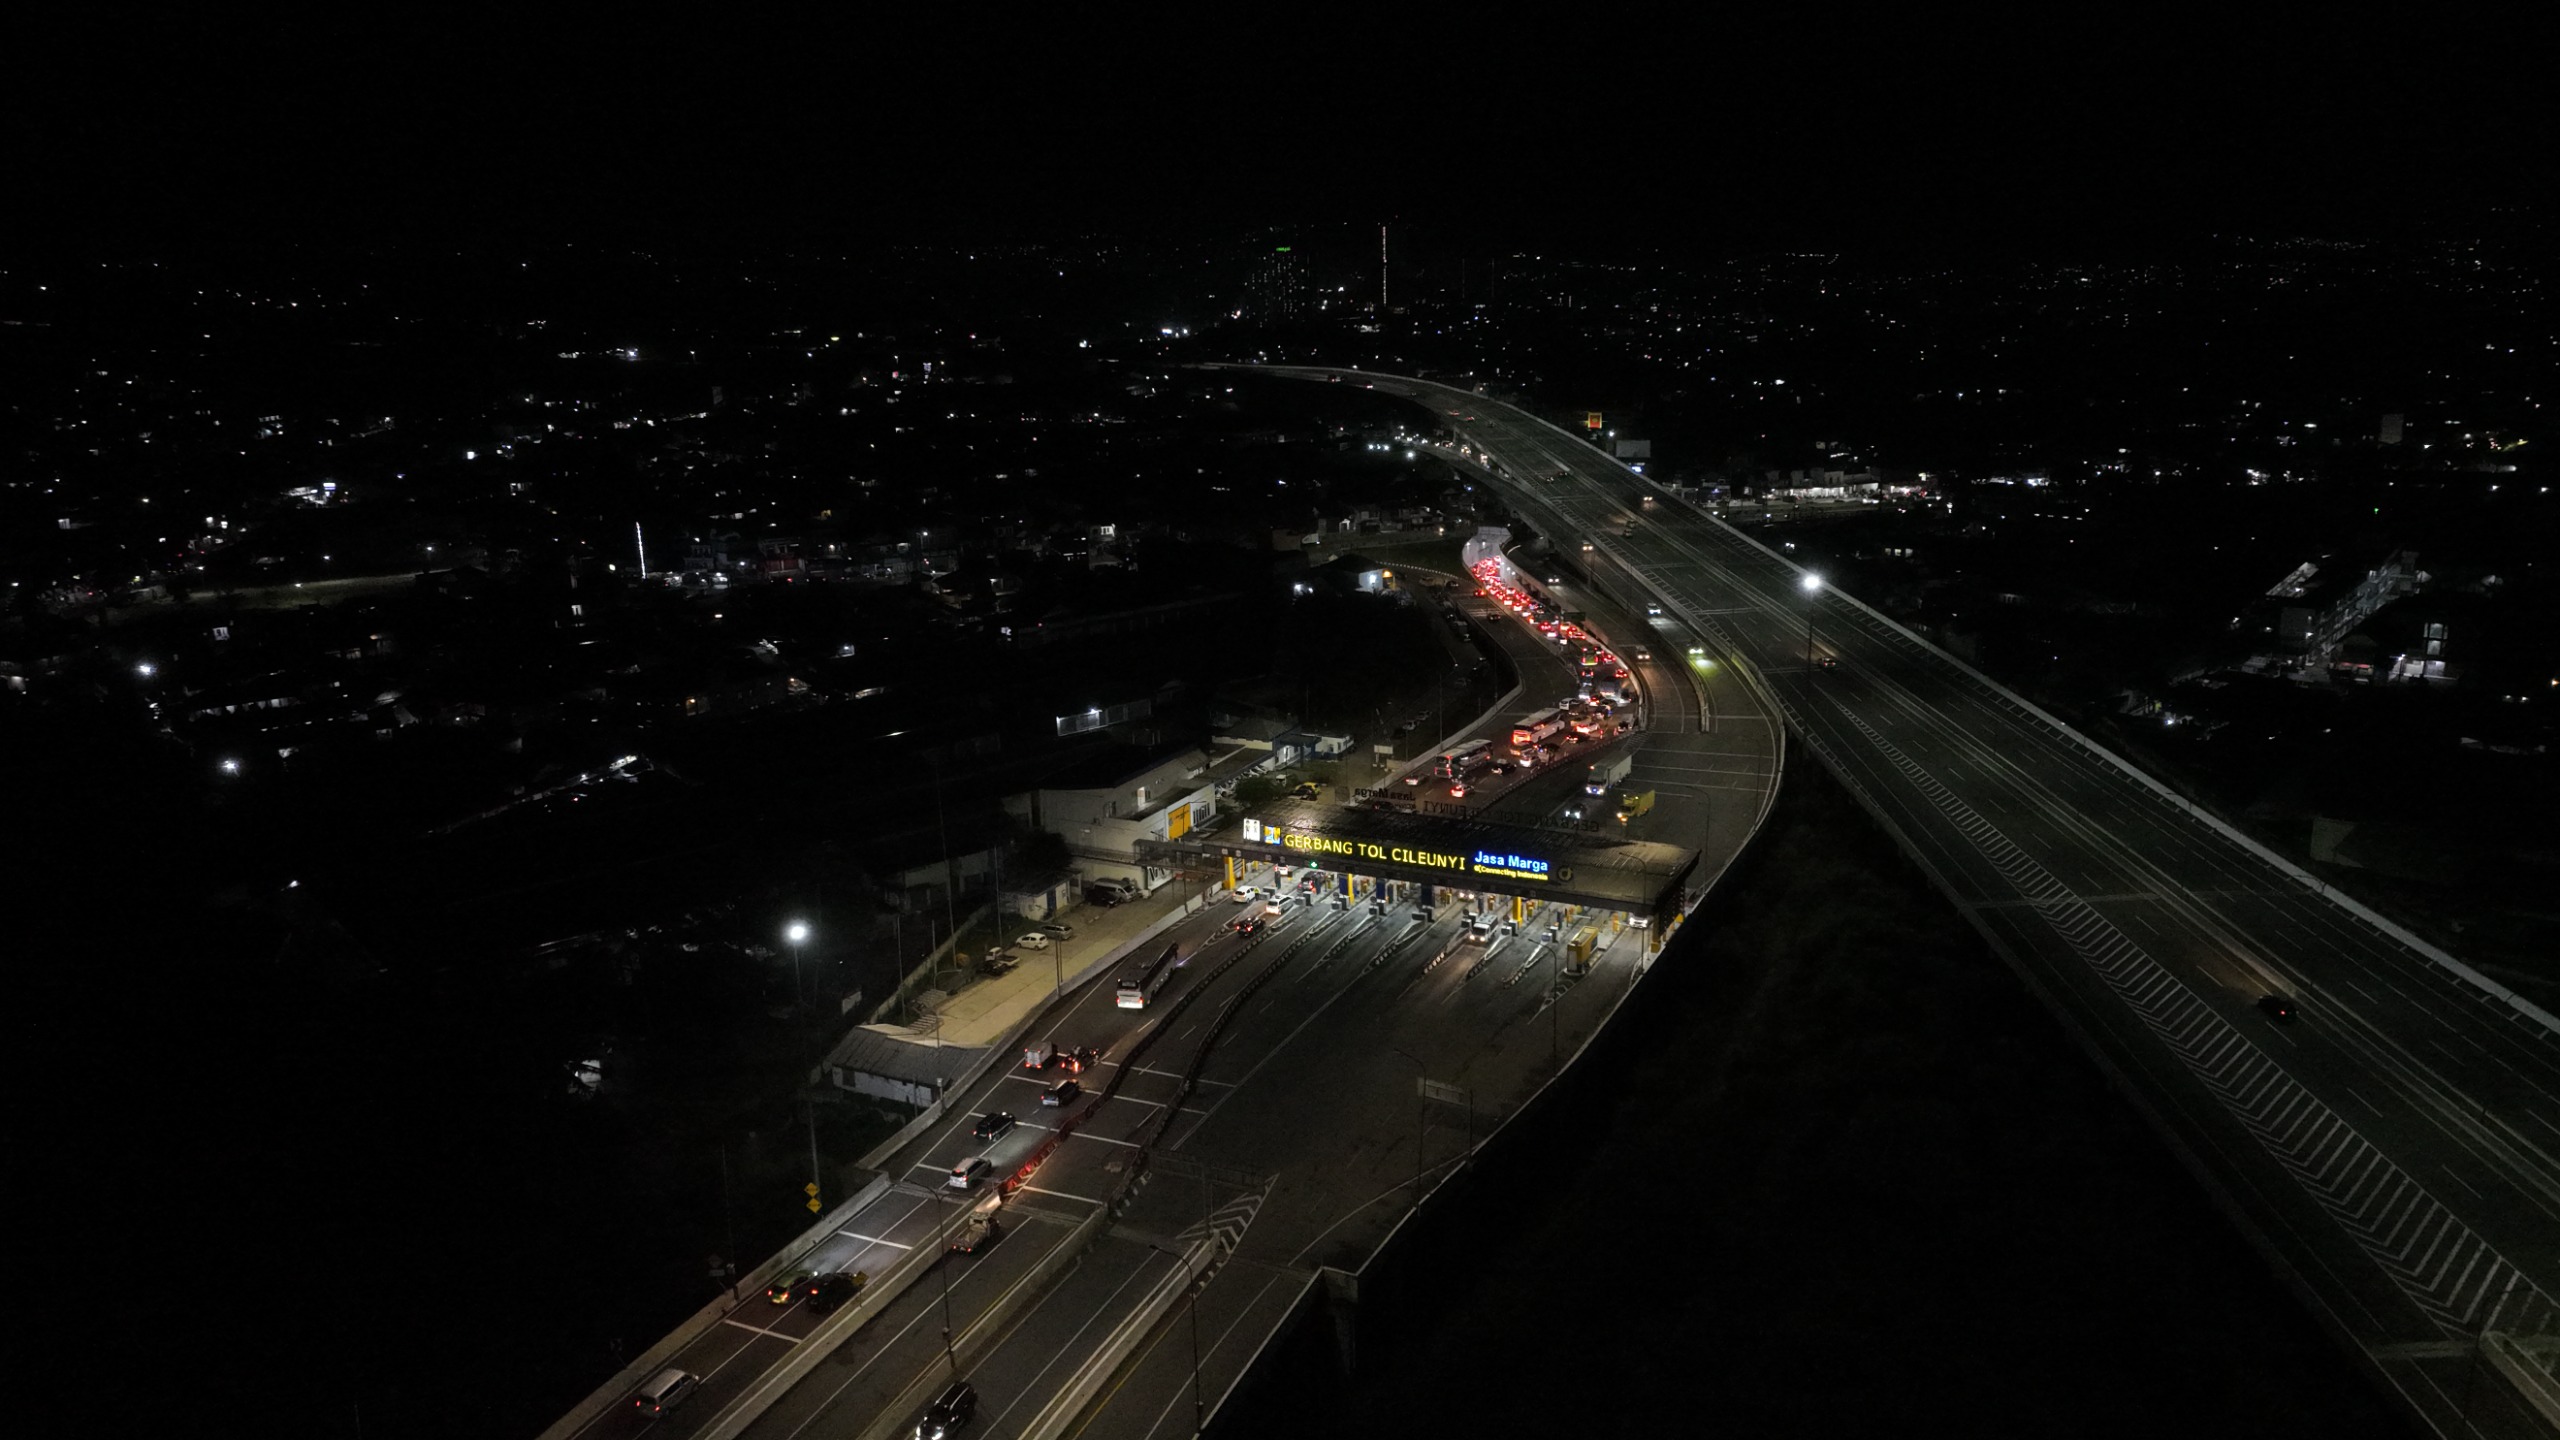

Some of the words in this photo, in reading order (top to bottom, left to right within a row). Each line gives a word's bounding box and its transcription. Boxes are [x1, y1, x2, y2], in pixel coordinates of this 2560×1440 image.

[1284, 834, 1353, 855] GERBANG
[1357, 843, 1387, 860] TOL
[1391, 848, 1466, 870] CILEUNYI
[1474, 850, 1505, 866] Jasa
[1508, 855, 1548, 872] Marga
